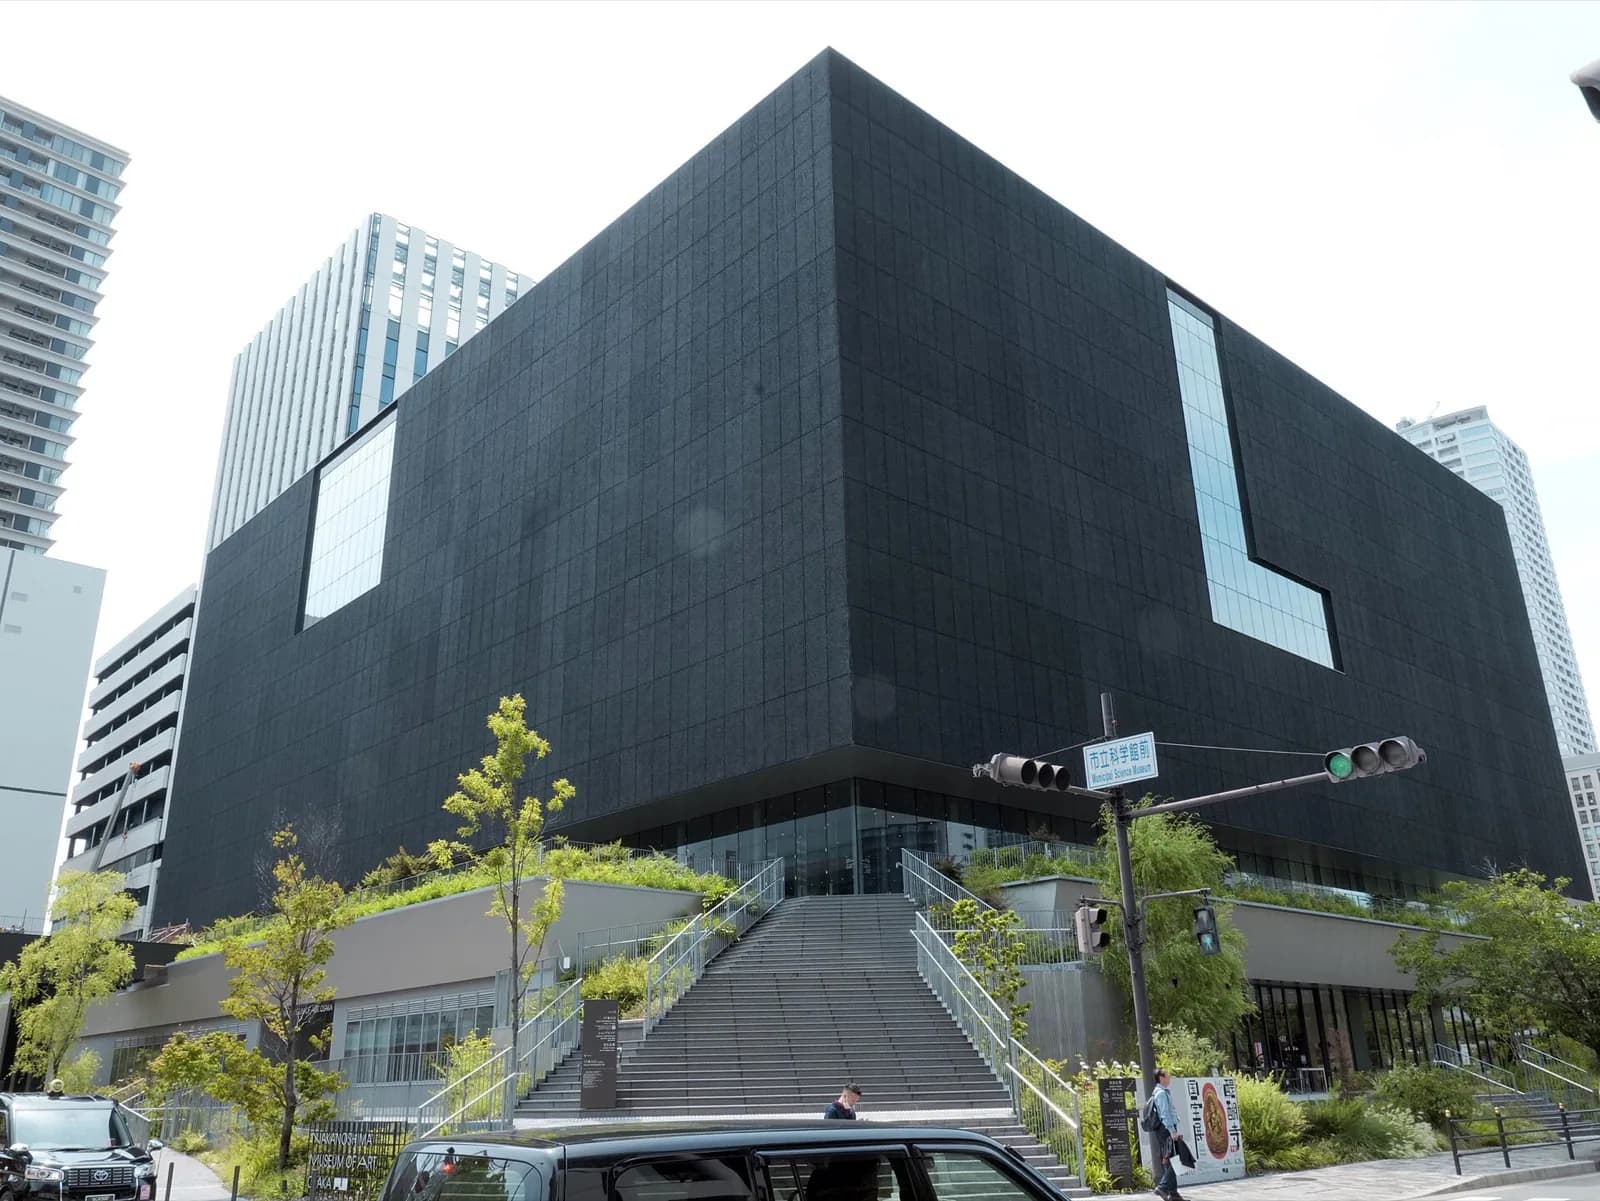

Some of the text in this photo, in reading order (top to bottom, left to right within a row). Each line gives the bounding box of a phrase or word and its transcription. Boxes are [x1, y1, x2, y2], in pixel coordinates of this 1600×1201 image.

[1089, 739, 1149, 769] 市立科学館前
[1091, 764, 1152, 784] Municipal Science Museum
[311, 1132, 372, 1146] NAKANOSHIMA
[308, 1154, 344, 1169] MUSEUM
[345, 1155, 357, 1169] OF
[307, 1175, 332, 1189] OAKA
